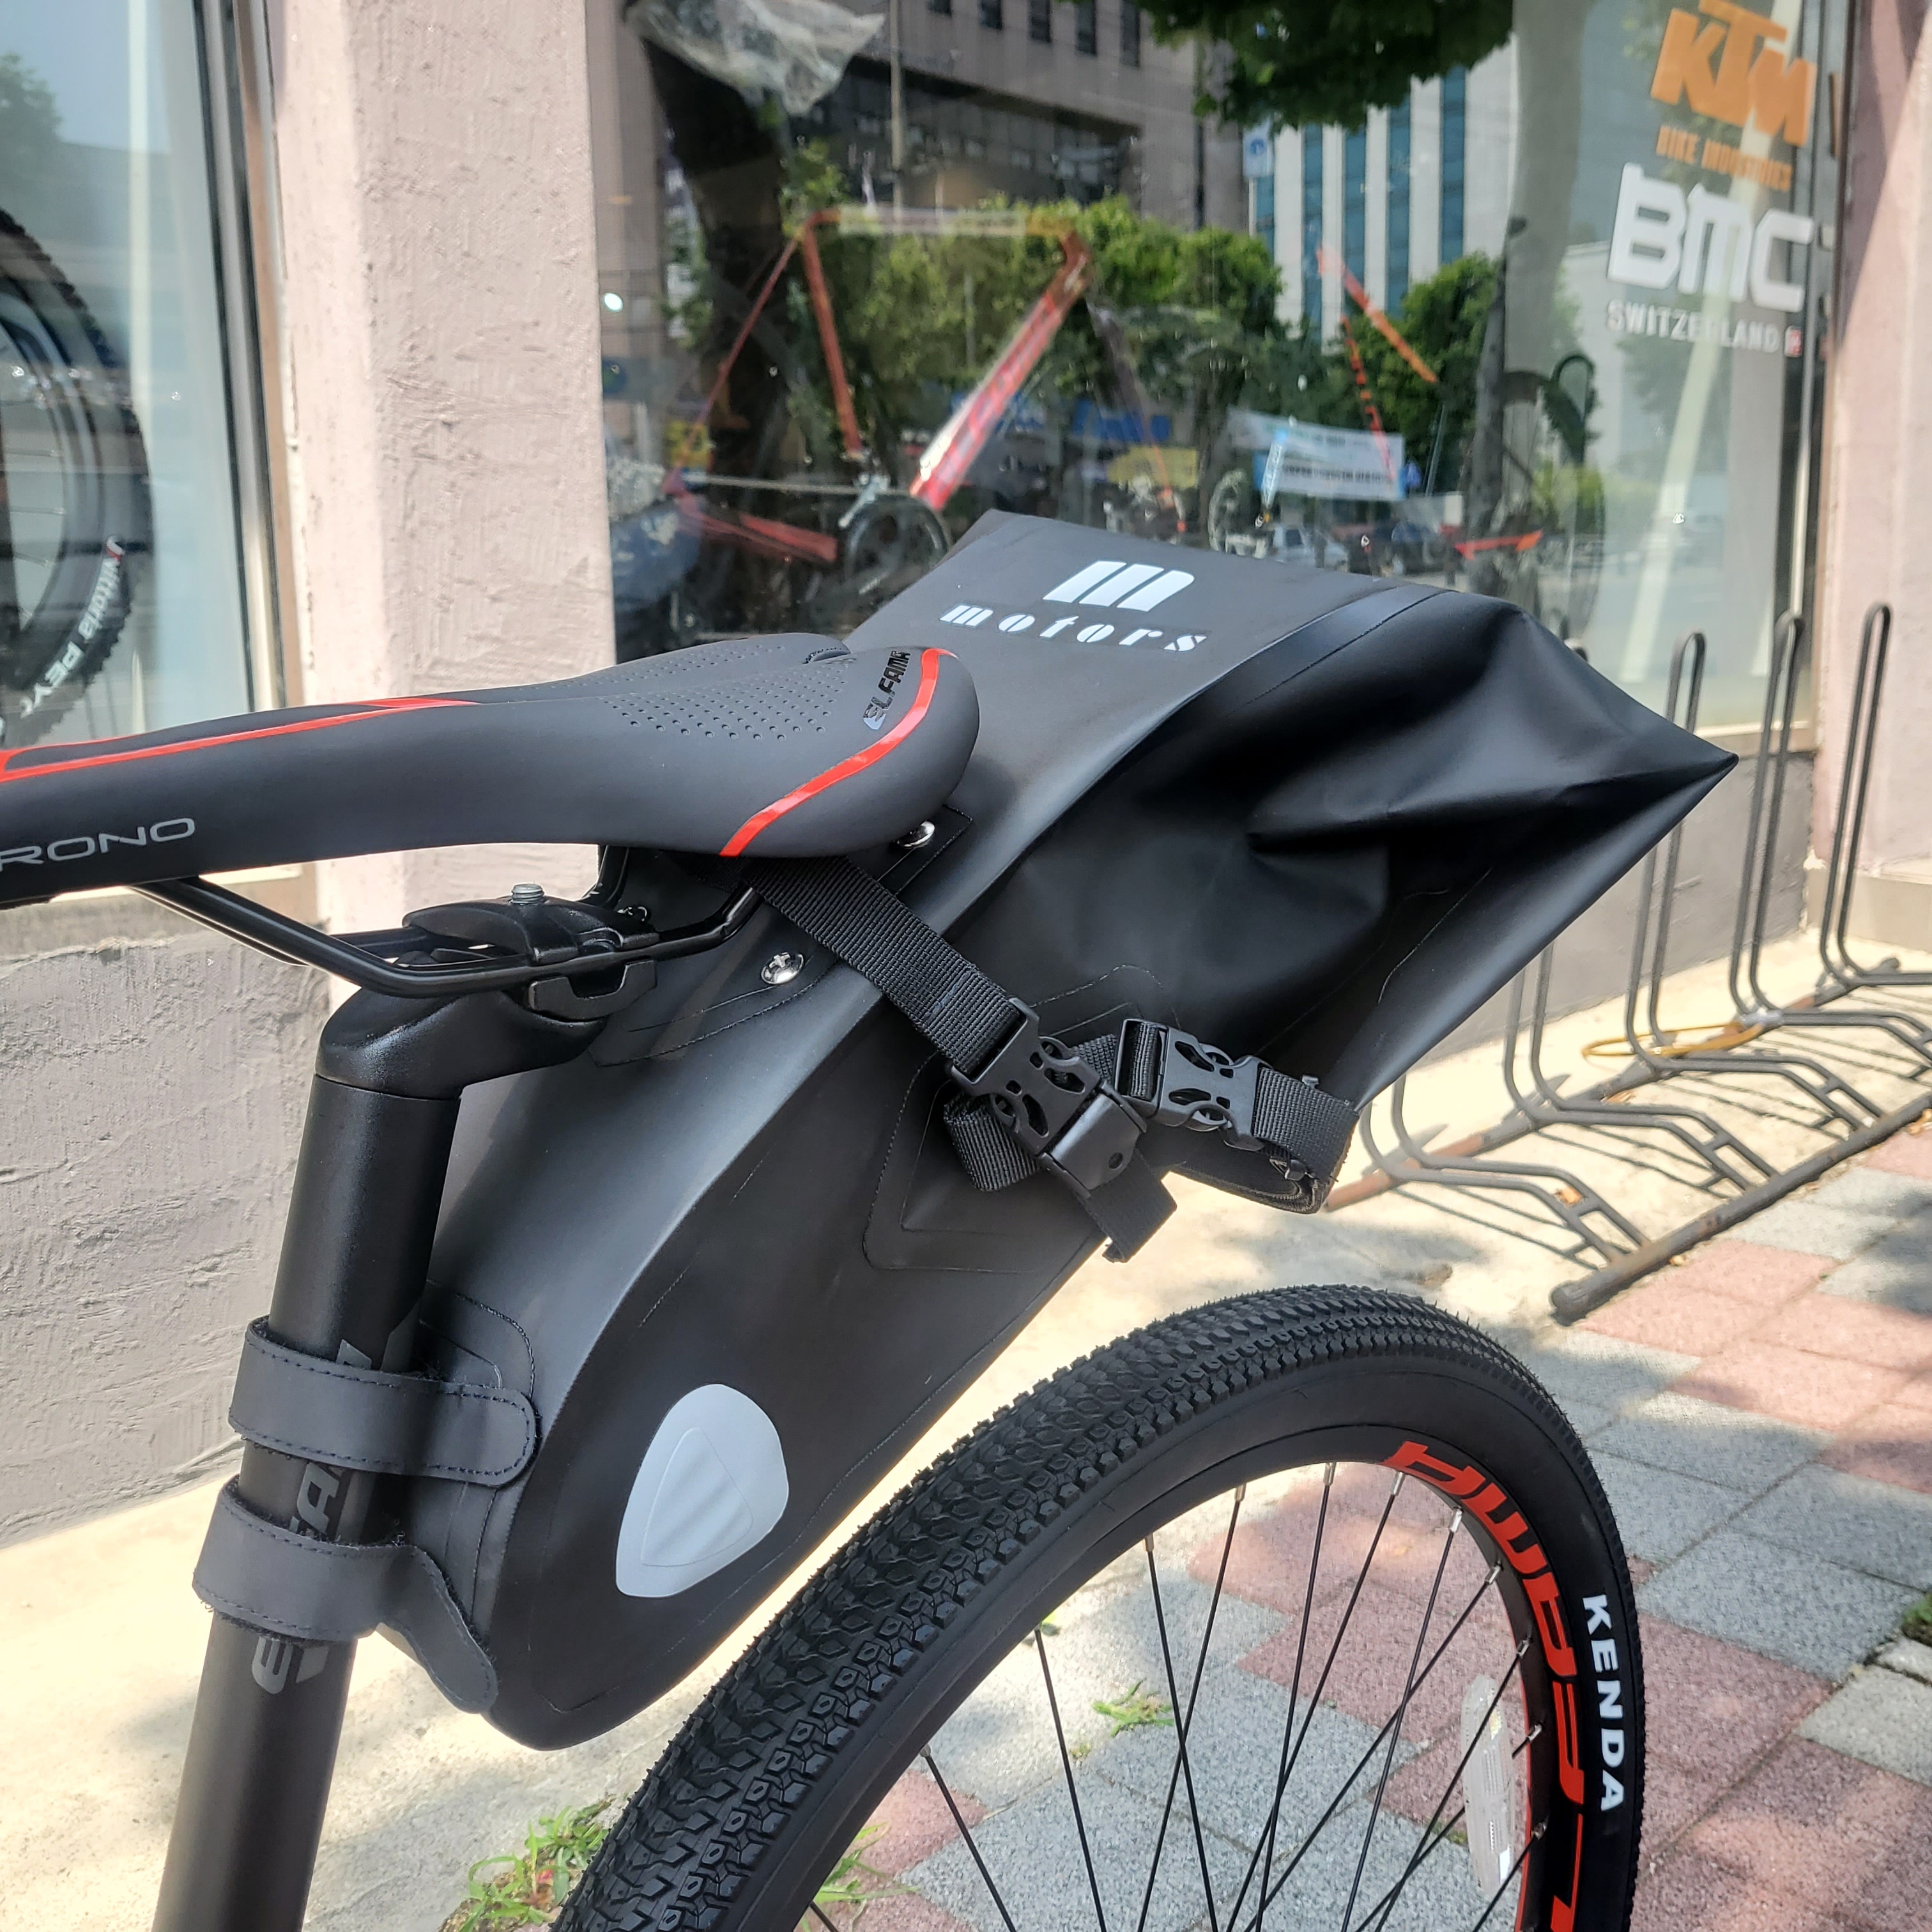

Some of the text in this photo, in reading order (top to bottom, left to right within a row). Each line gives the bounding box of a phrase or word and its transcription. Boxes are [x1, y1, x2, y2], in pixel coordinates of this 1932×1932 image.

[1650, 0, 1817, 147] KTM
[1655, 125, 1699, 164] BIKE
[1607, 162, 1814, 312] BMC
[939, 604, 1208, 652] motors
[862, 650, 911, 730] ELFAMA
[1582, 1593, 1626, 1813] KENDA
